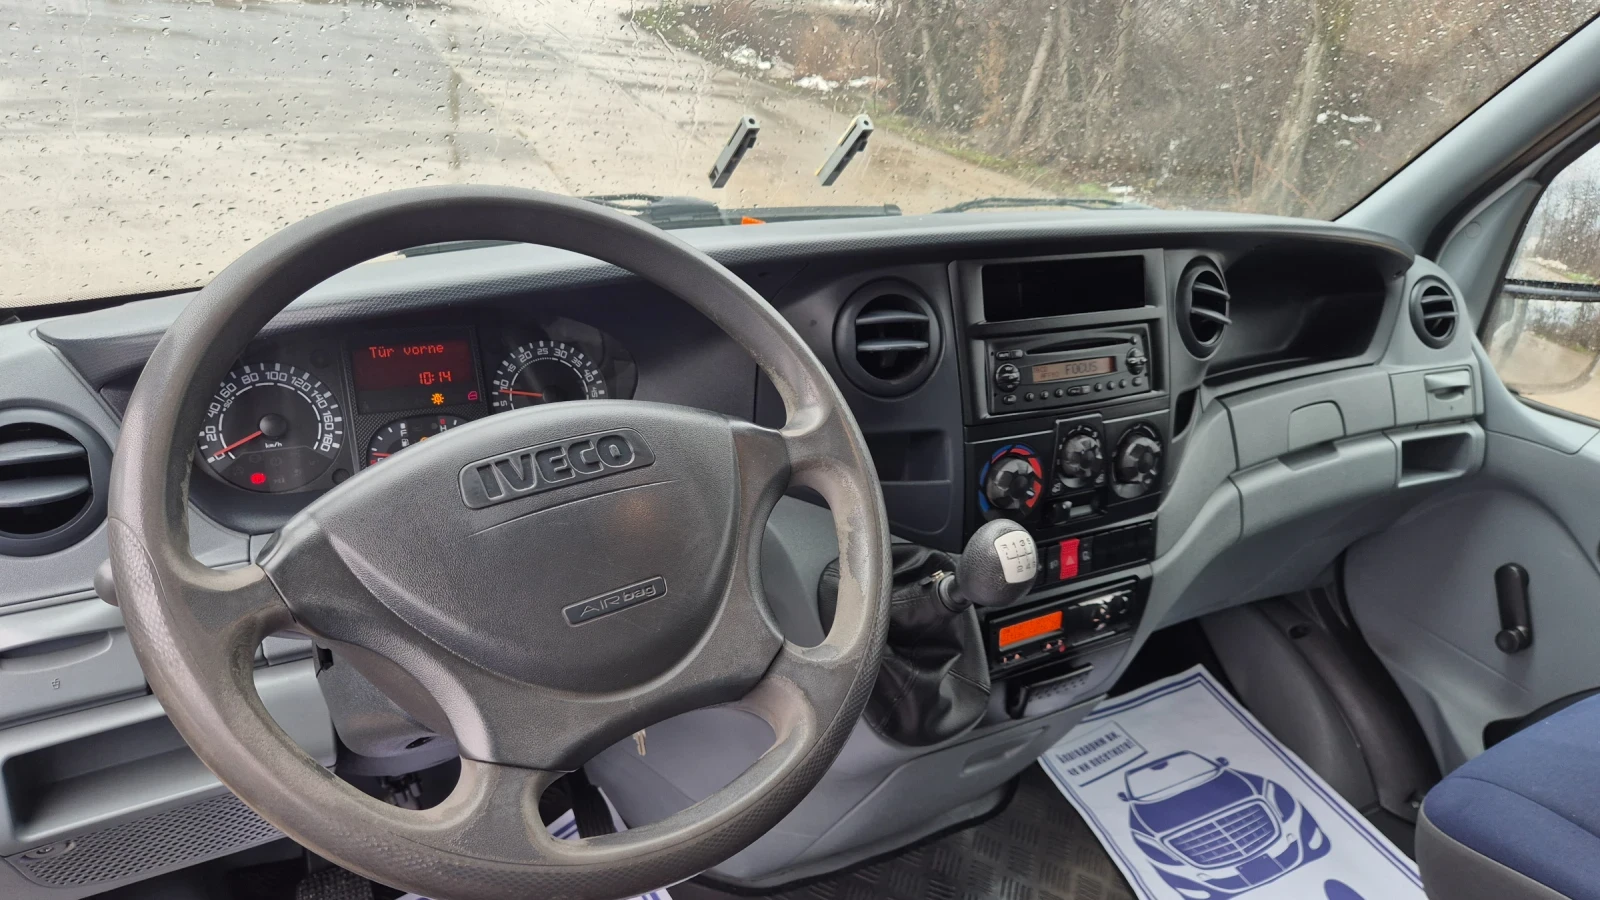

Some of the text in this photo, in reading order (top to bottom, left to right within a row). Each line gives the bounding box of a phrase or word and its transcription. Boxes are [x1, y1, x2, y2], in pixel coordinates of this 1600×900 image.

[369, 344, 444, 358] Tür vorne
[518, 350, 532, 363] 20
[537, 348, 548, 356] 25
[554, 348, 567, 359] 30
[508, 363, 516, 373] 15
[571, 357, 583, 368] 35
[1065, 360, 1097, 375] FOCUS
[241, 372, 259, 384] 80
[265, 371, 288, 382] 100
[419, 371, 452, 385] 10:14
[584, 369, 594, 382] 40
[220, 382, 237, 398] 60
[291, 376, 312, 392] 120
[500, 379, 509, 390] 10
[591, 386, 599, 398] 45
[311, 390, 328, 409] 140
[208, 402, 221, 418] 40
[322, 411, 334, 430] 160
[205, 425, 217, 441] 20
[320, 433, 333, 452] 180
[476, 434, 636, 500] IVECO
